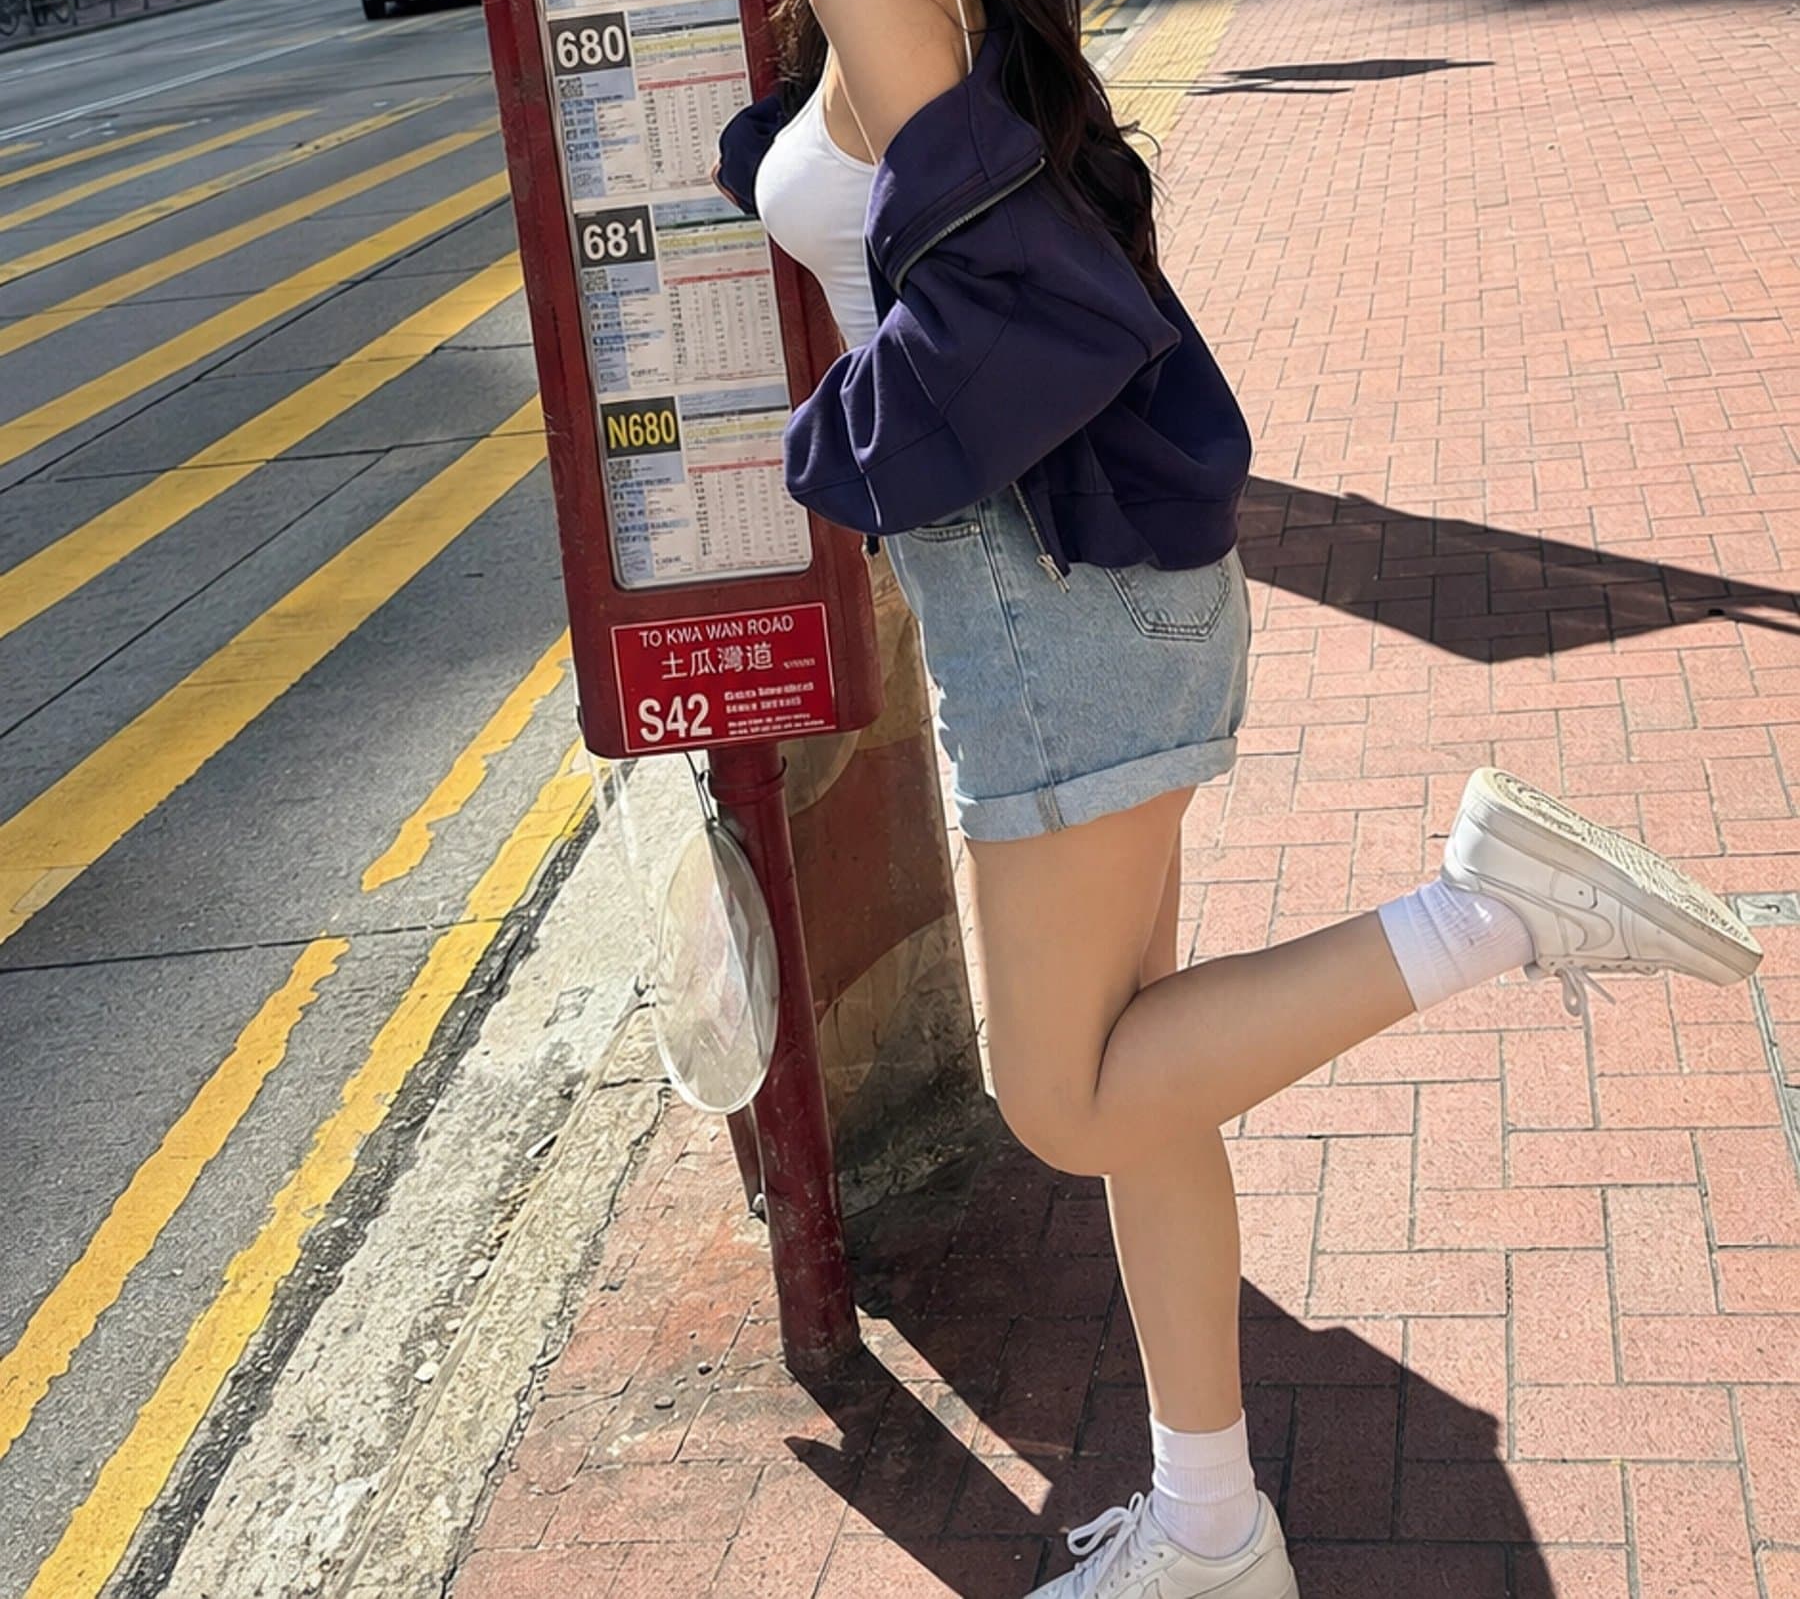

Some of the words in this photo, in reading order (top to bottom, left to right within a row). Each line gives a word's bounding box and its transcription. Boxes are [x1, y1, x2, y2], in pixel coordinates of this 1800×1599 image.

[555, 23, 626, 69] 680
[582, 218, 650, 261] 681
[606, 410, 676, 450] N680
[638, 629, 664, 648] TO
[666, 625, 704, 646] KWA
[705, 620, 745, 641] WAN
[747, 614, 795, 636] ROAD
[661, 641, 774, 681] 土瓜灣道
[637, 692, 714, 743] S42
